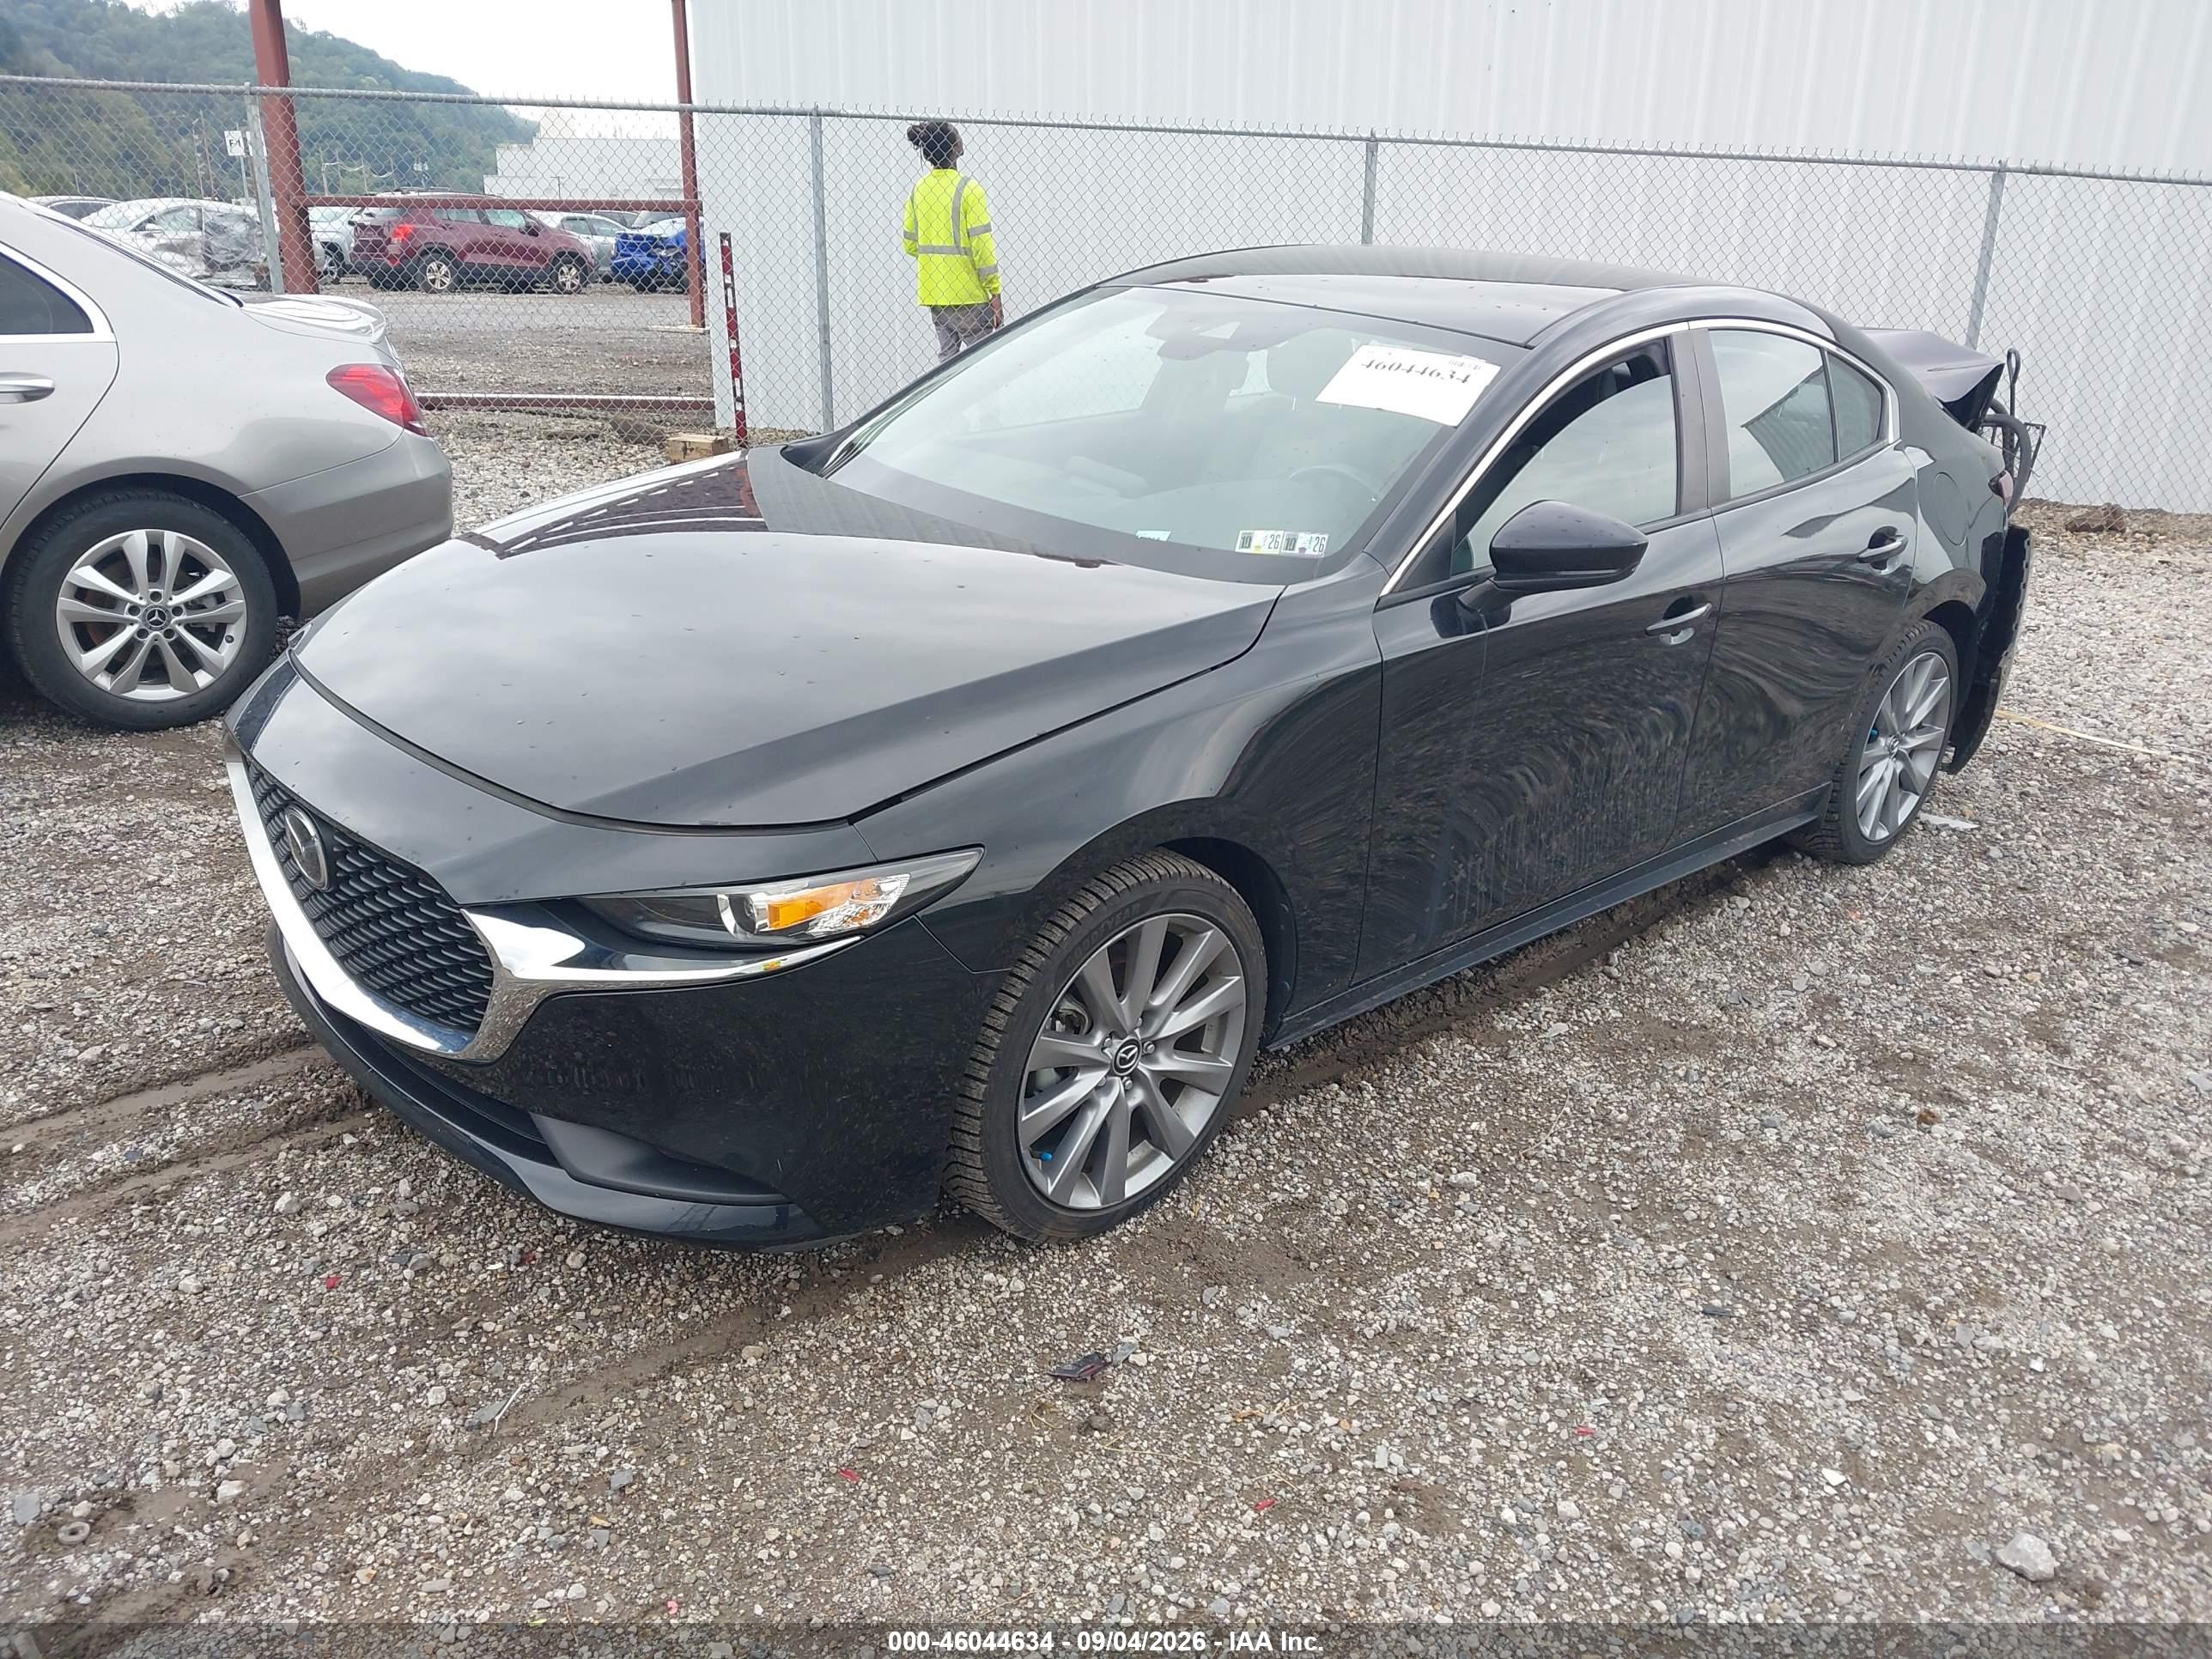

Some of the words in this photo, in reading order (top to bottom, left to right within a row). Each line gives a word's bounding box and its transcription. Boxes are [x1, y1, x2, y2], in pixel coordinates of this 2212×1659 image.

[1360, 359, 1471, 384] 46044634
[1267, 534, 1280, 550] 26
[1312, 536, 1326, 553] 26
